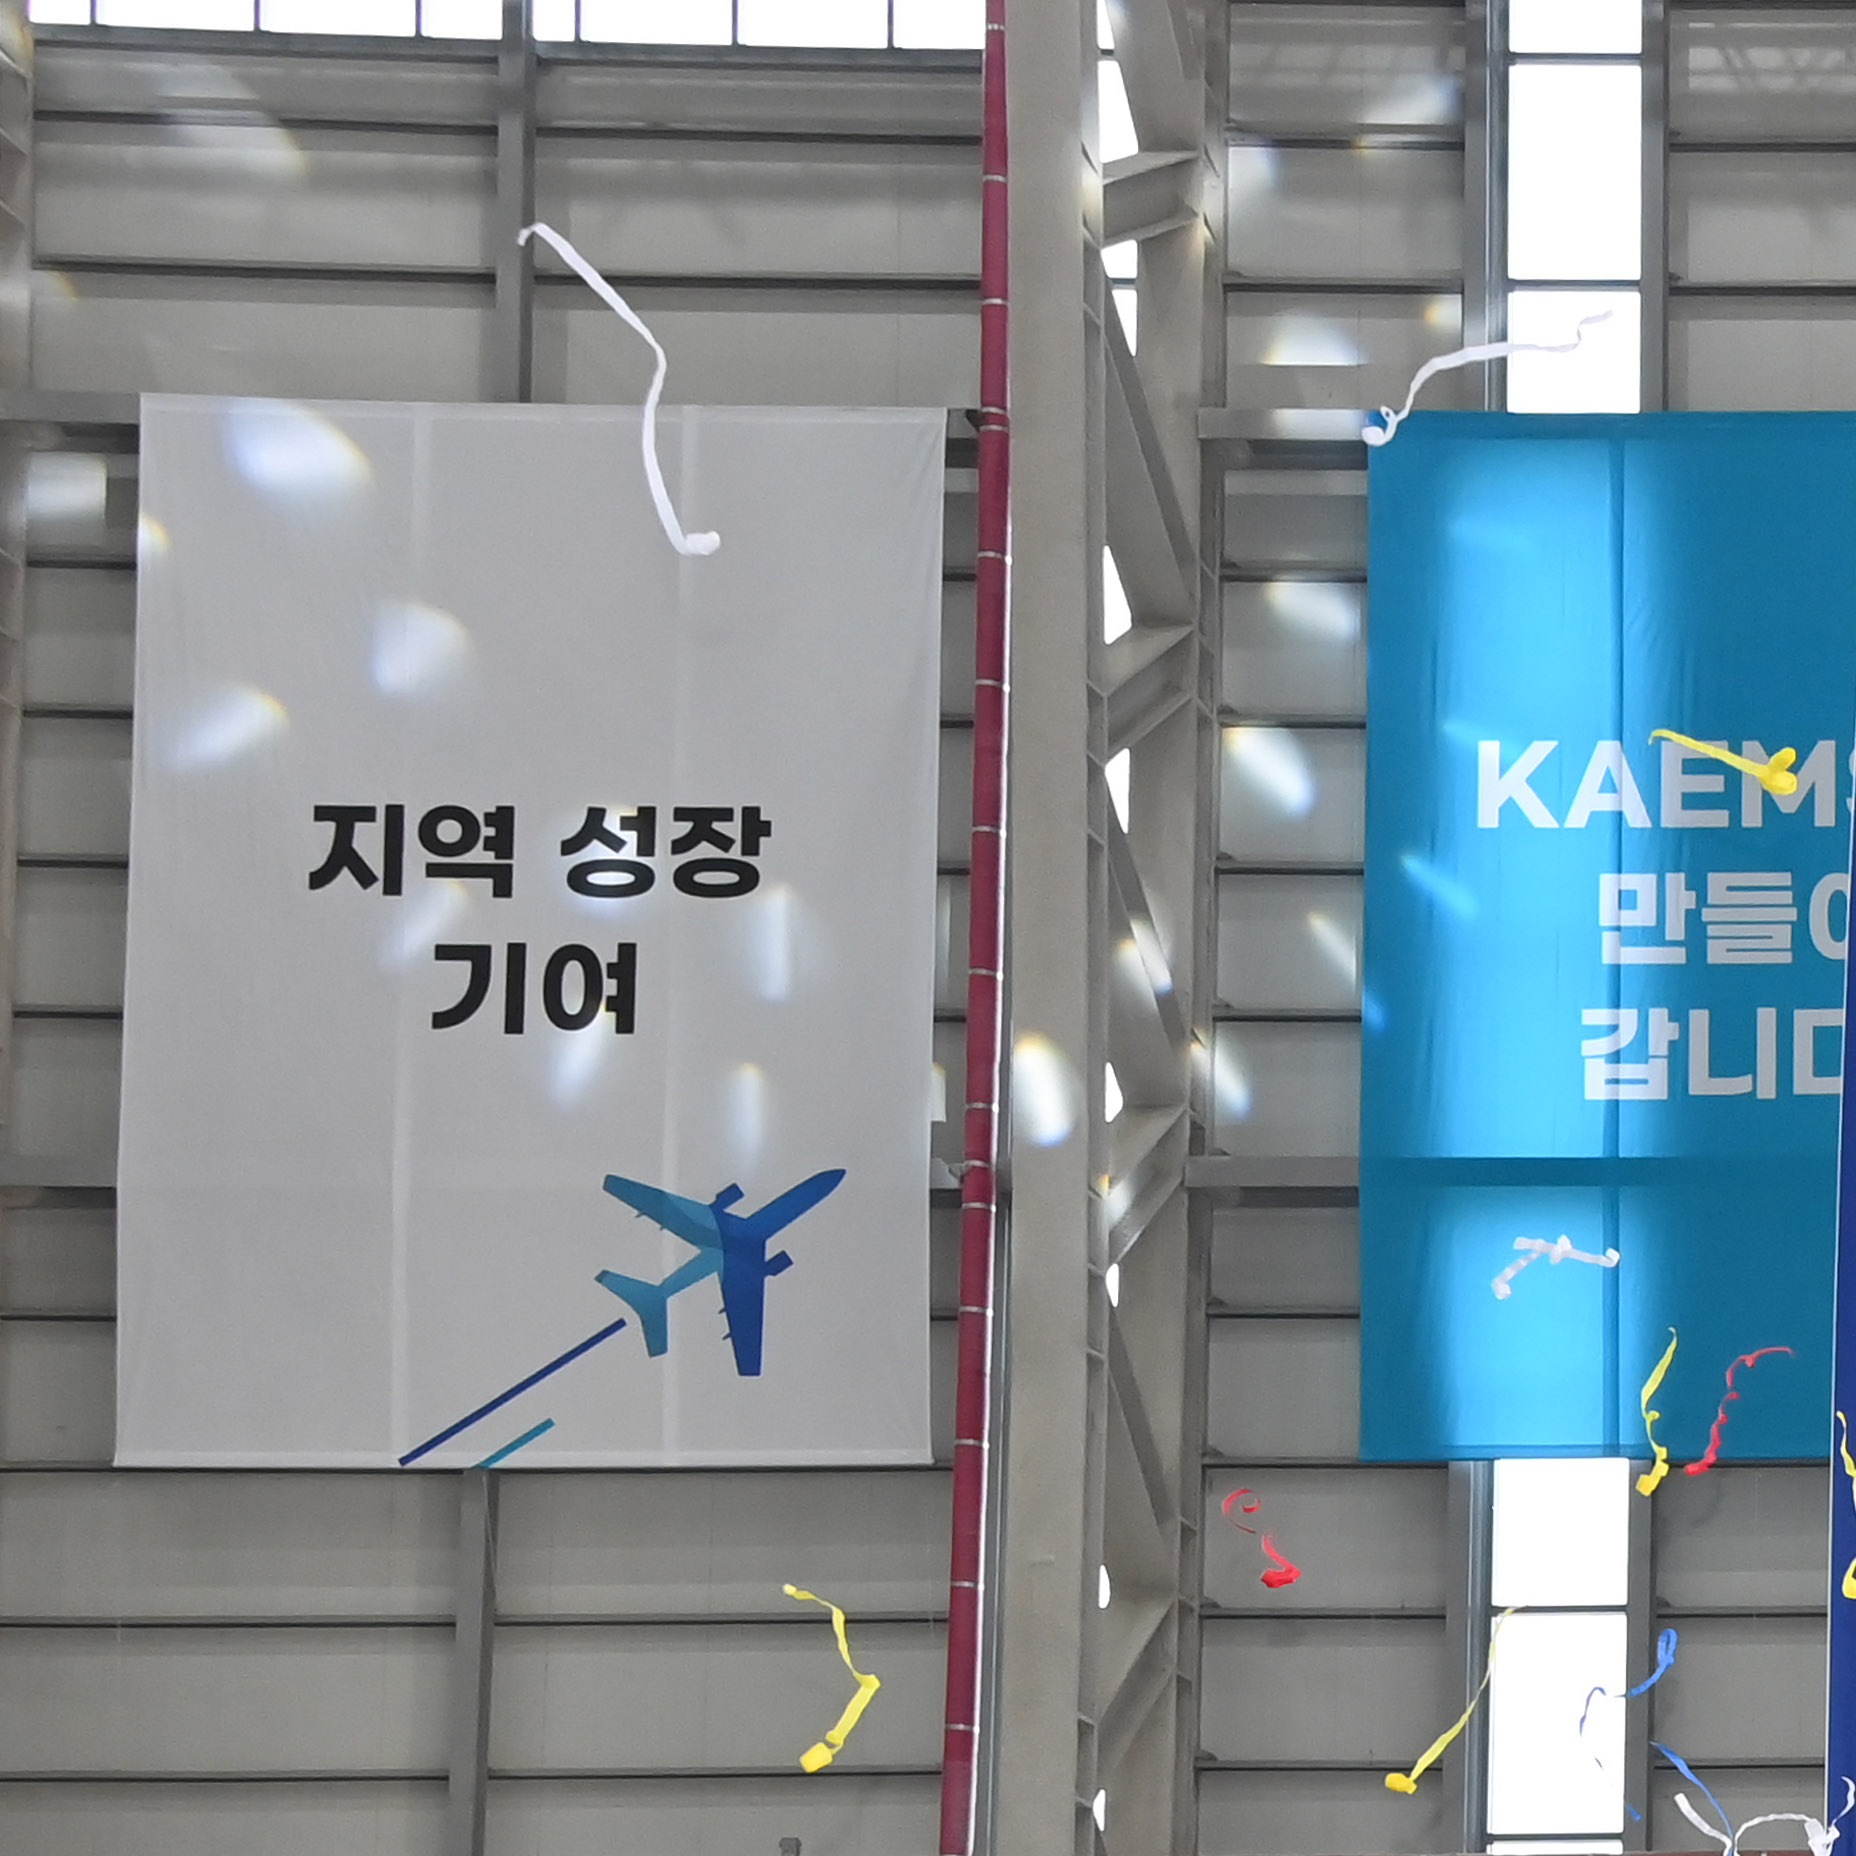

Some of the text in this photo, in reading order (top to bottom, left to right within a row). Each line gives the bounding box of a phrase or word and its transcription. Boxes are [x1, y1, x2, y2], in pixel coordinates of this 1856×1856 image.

[1476, 739, 1856, 829] KAEM
[308, 803, 772, 899] 지역 성장
[431, 942, 638, 1036] 기여
